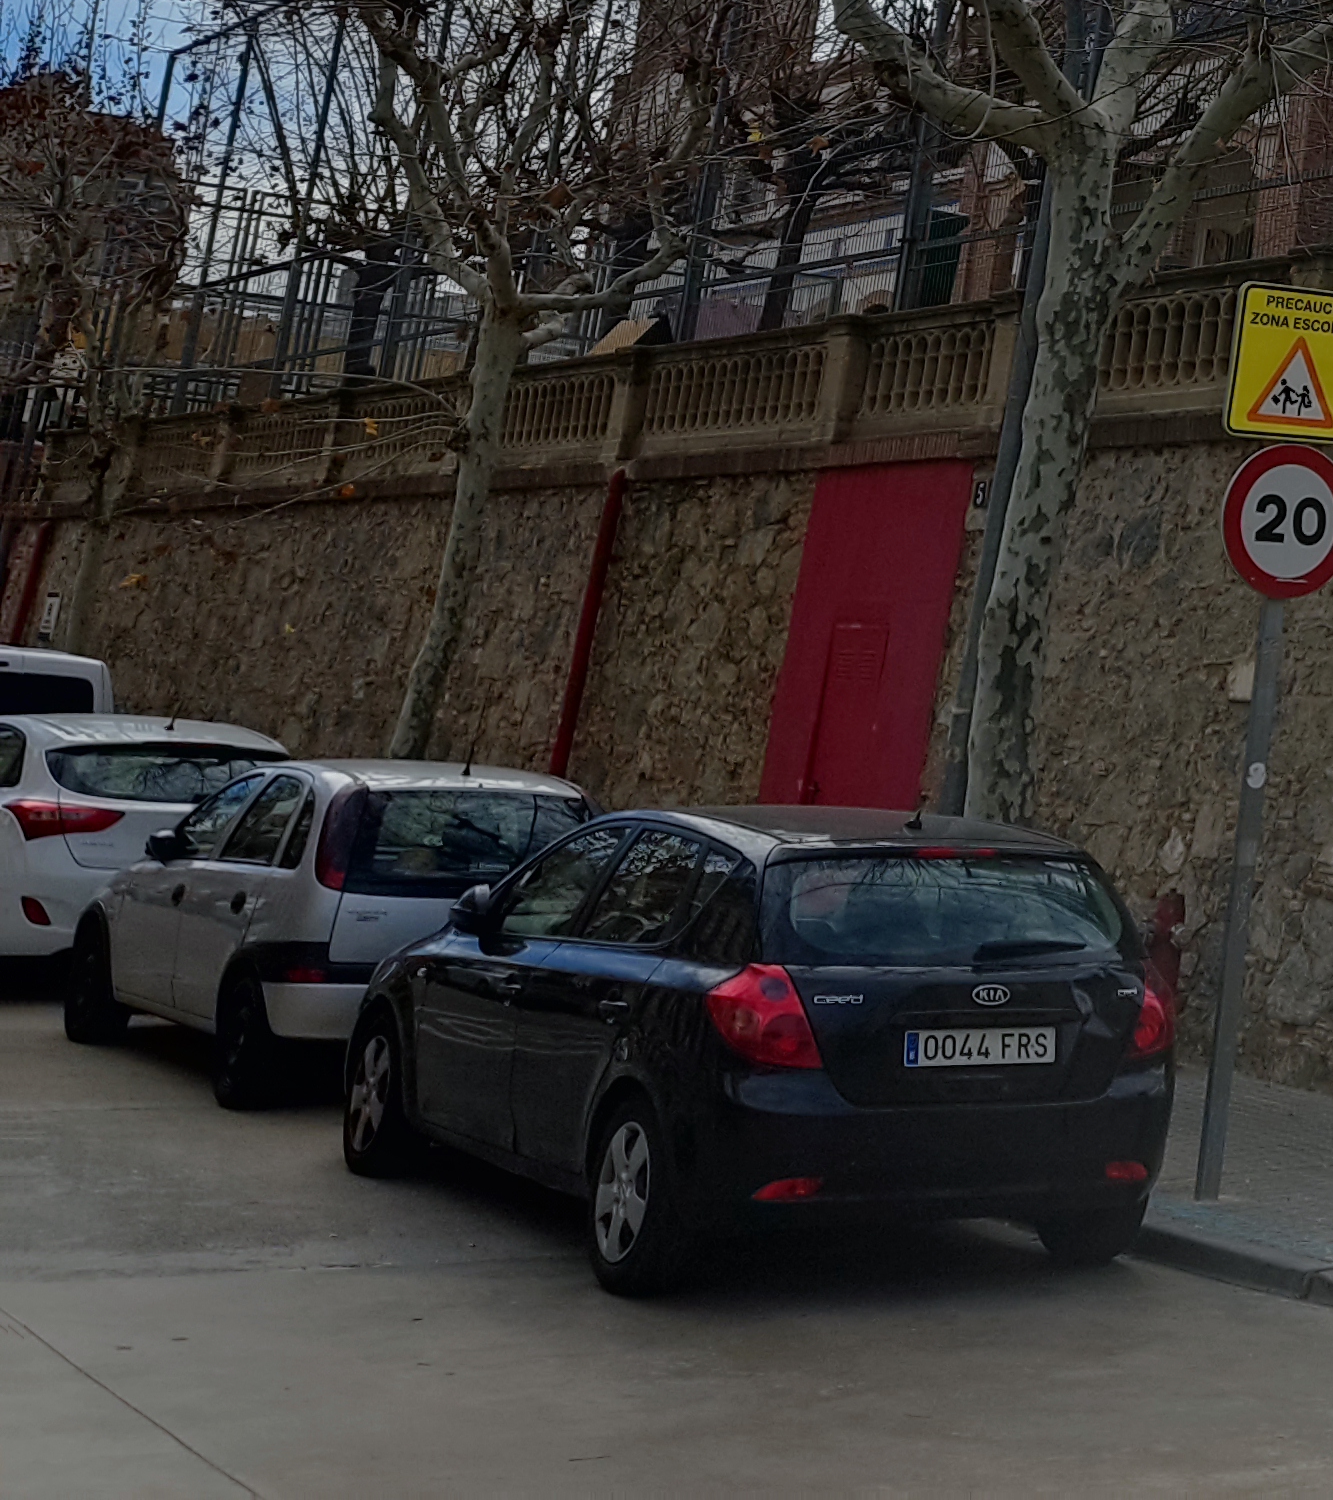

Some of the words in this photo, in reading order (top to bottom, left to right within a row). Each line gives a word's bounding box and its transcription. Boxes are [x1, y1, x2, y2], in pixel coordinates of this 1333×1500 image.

[1250, 312, 1289, 328] ZONA
[976, 482, 985, 505] 5
[1254, 494, 1327, 546] 20
[978, 988, 1006, 1001] KIA
[924, 1033, 990, 1060] 0044
[1001, 1032, 1048, 1059] FRS
